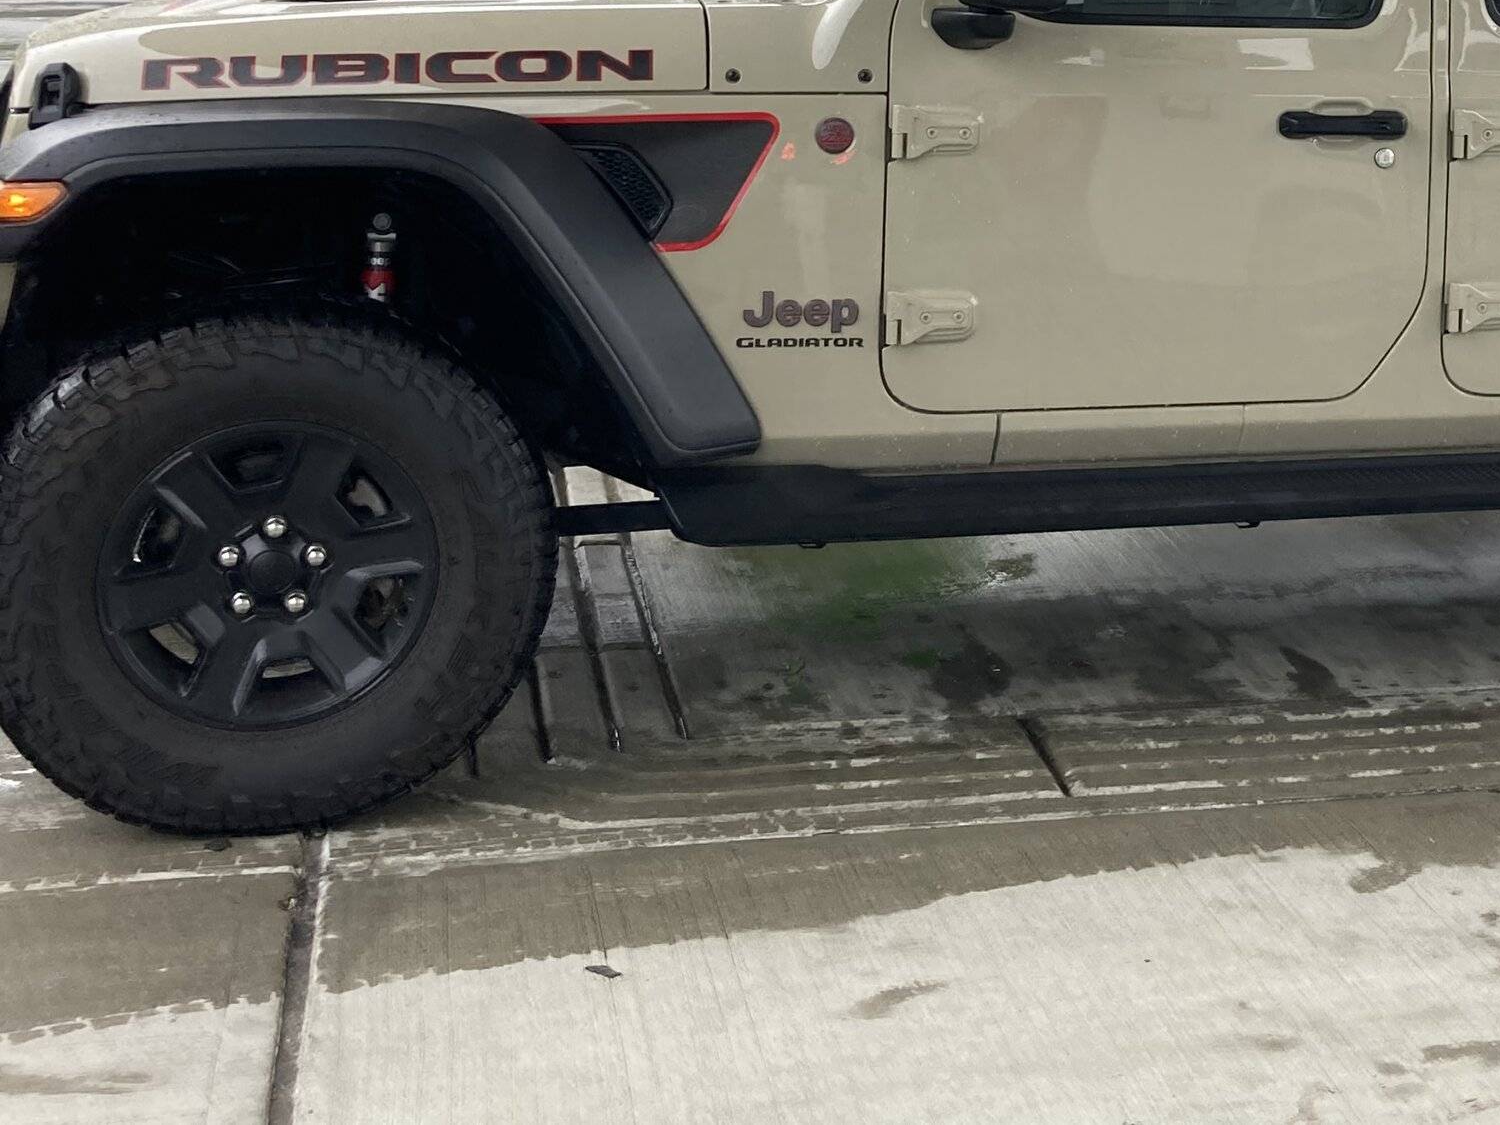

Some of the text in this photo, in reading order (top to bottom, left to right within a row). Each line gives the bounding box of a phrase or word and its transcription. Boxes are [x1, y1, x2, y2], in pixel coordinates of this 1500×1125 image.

[141, 49, 654, 91] RUBICON
[743, 291, 859, 333] Jeep
[736, 337, 864, 348] GLADIATOR
